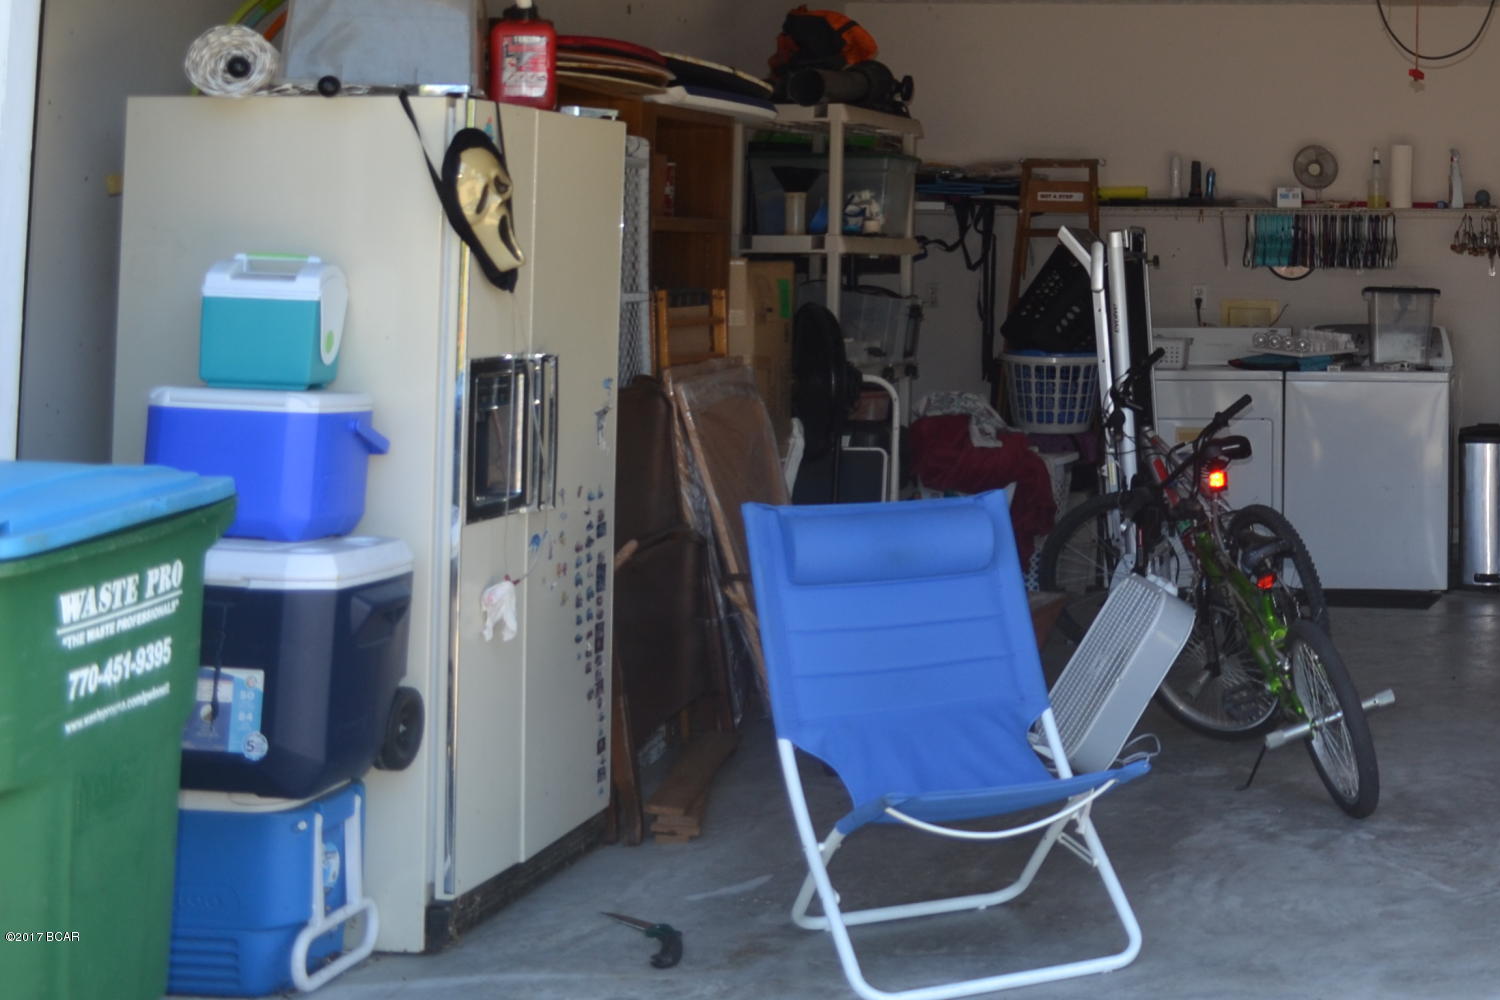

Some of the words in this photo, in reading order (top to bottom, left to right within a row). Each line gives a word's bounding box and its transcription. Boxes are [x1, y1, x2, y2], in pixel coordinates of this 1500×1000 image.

[59, 574, 139, 625] WASTE
[145, 559, 184, 599] PRO
[68, 635, 172, 703] 770-451-9395
